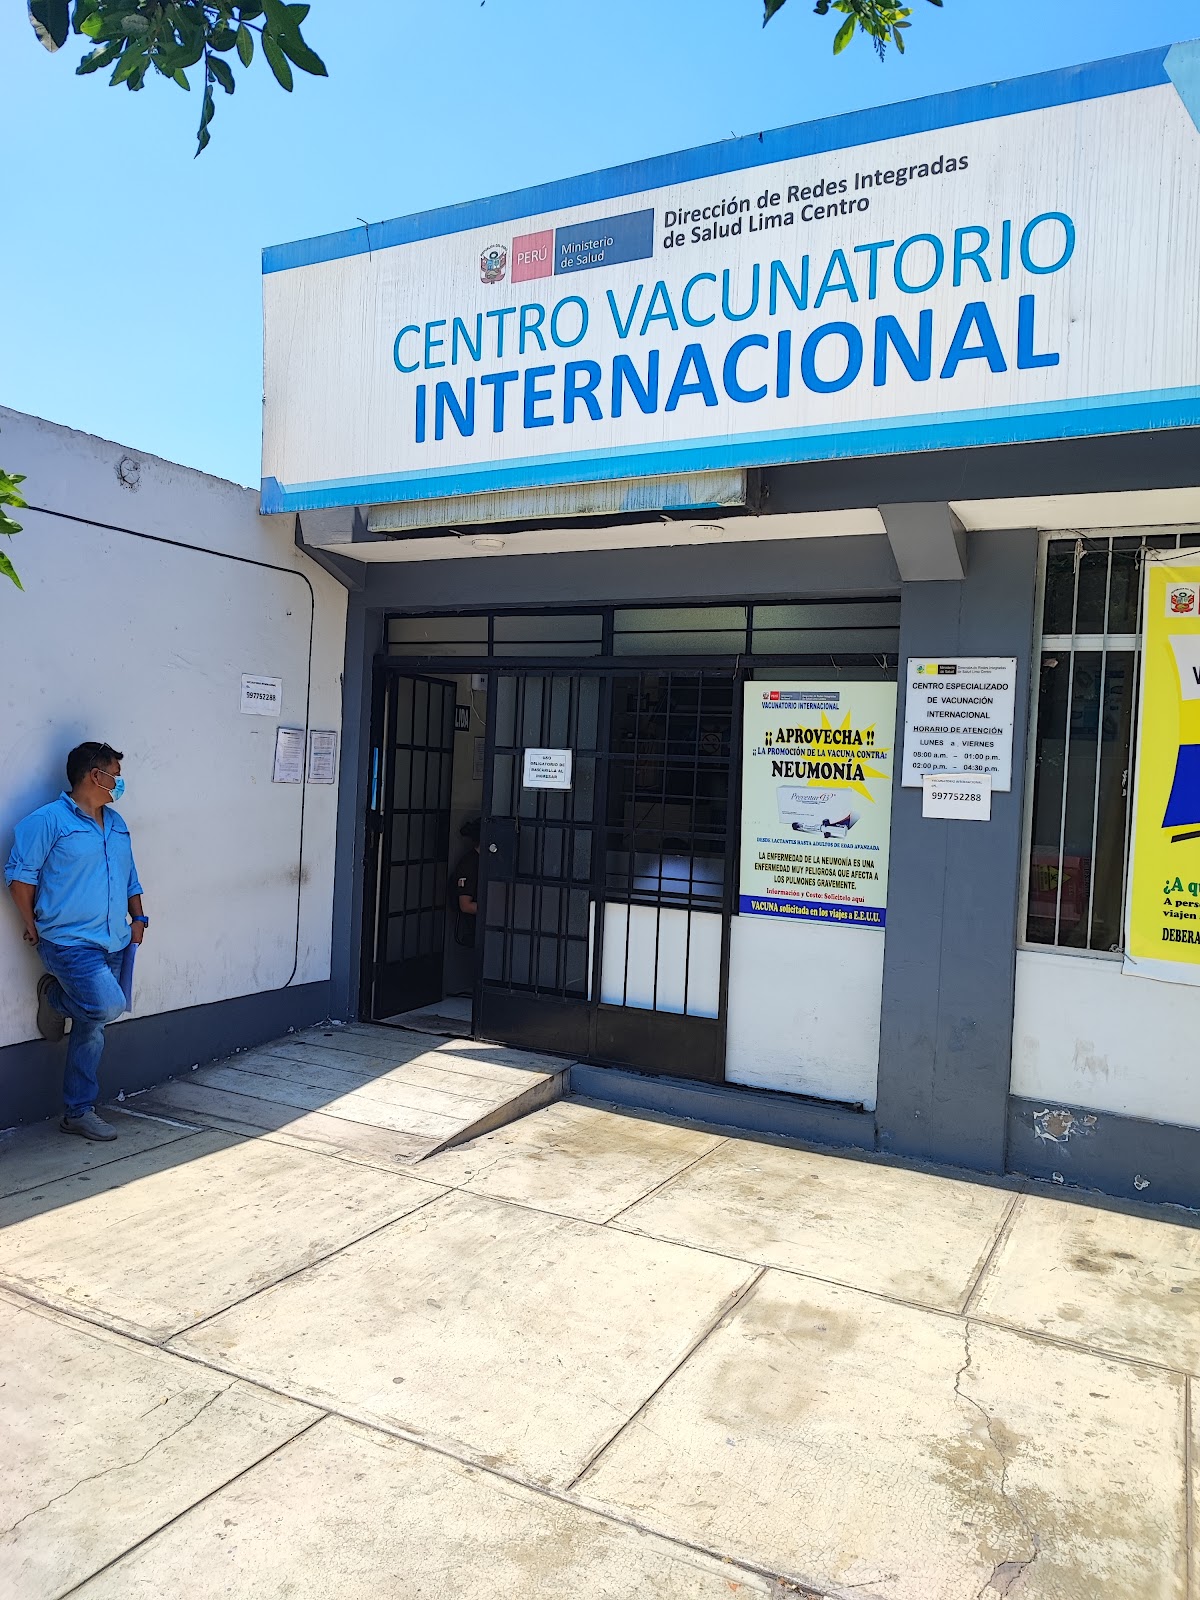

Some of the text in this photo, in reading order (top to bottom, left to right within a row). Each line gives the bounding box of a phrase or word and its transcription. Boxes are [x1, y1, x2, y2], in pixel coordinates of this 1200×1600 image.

[664, 155, 969, 228] Dirección de Redes Integradas
[663, 196, 870, 249] de Salud Lima Centro
[561, 236, 614, 255] Ministerio
[517, 245, 548, 265] PERÚ
[560, 251, 605, 268] de Salud
[392, 209, 1076, 375] CENTRO VACUNATORIO
[415, 293, 1060, 444] INTERNACIONAL
[912, 682, 1009, 691] CENTRO ESPECIALIZADO
[761, 701, 840, 710] VACUNATORIO INTERNACIONAL
[927, 696, 993, 705] DE VACUNACIÓN
[455, 707, 469, 729] LIDA
[926, 711, 990, 719] INTERNACIONAL
[775, 727, 863, 746] APROVECHA
[866, 730, 875, 746] !!
[913, 725, 949, 733] HORARIO
[962, 726, 1003, 734] ATENCIÓN
[767, 746, 806, 757] PROMOCIÓN
[806, 748, 816, 757] DE
[817, 748, 826, 757] LA
[827, 749, 855, 758] VACUNA
[856, 750, 888, 759] CONTRA:
[962, 740, 995, 748] VIERNES
[771, 758, 866, 781] NEUMONÍA
[931, 791, 982, 802] 997752288
[758, 851, 875, 868] LA ENFERMEDAD DE LA NEUMONÍA ES UNA
[754, 862, 879, 881] ENFERMEDAD MUY PELIGROSA QUE AFECTA A
[773, 875, 857, 890] LOS PULMONES GRAVEMENTE.
[1163, 876, 1184, 895] ¿A
[750, 900, 778, 912] VACUNA
[779, 903, 809, 916] solicitada
[810, 908, 818, 917] en
[818, 907, 829, 917] los
[829, 909, 848, 921] viajes
[853, 911, 881, 922] E.E.U.U.
[1163, 897, 1200, 908] A pers
[1162, 909, 1197, 920] viajen
